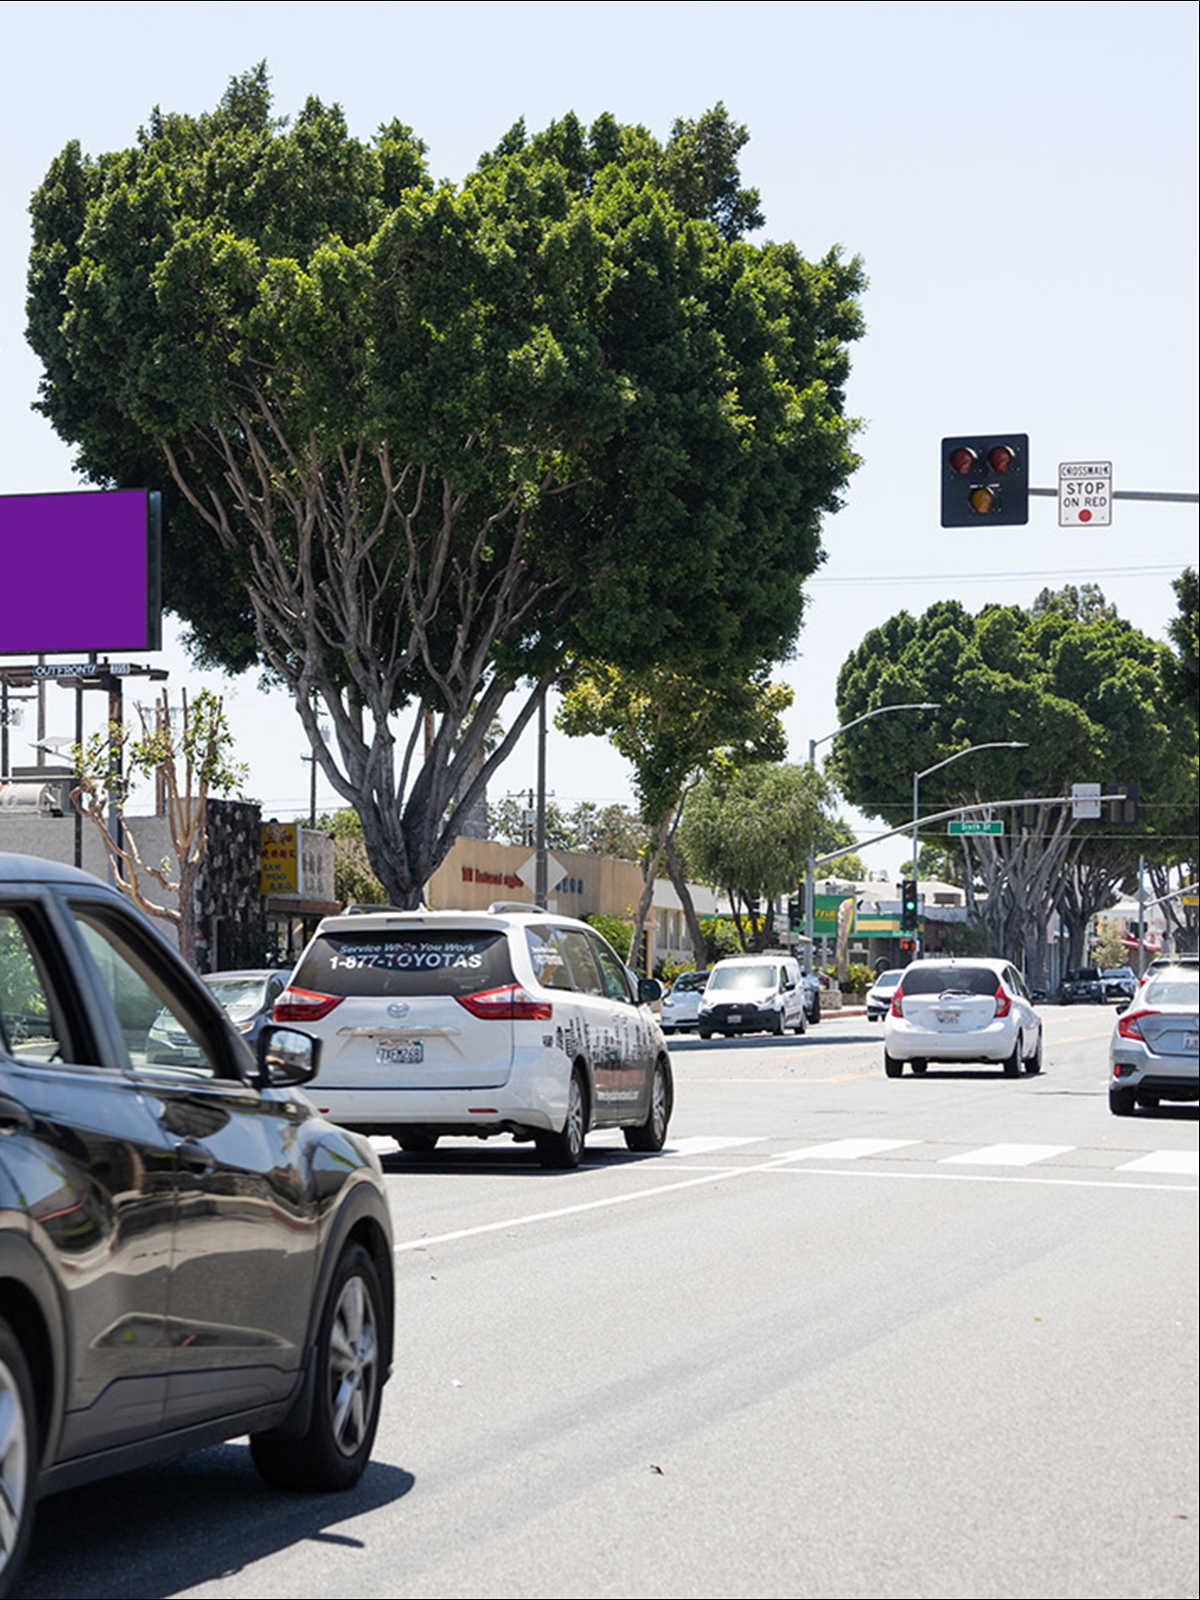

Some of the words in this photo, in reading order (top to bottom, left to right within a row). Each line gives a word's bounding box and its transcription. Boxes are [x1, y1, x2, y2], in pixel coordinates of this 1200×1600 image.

[1062, 465, 1110, 477] CROSSWALK
[1066, 481, 1105, 495] STOP
[1063, 497, 1080, 508] ON
[1084, 496, 1107, 507] RED
[339, 944, 382, 953] Service
[419, 943, 441, 951] You
[444, 943, 475, 952] Work
[329, 953, 482, 970] 1-877-TOYOTAS
